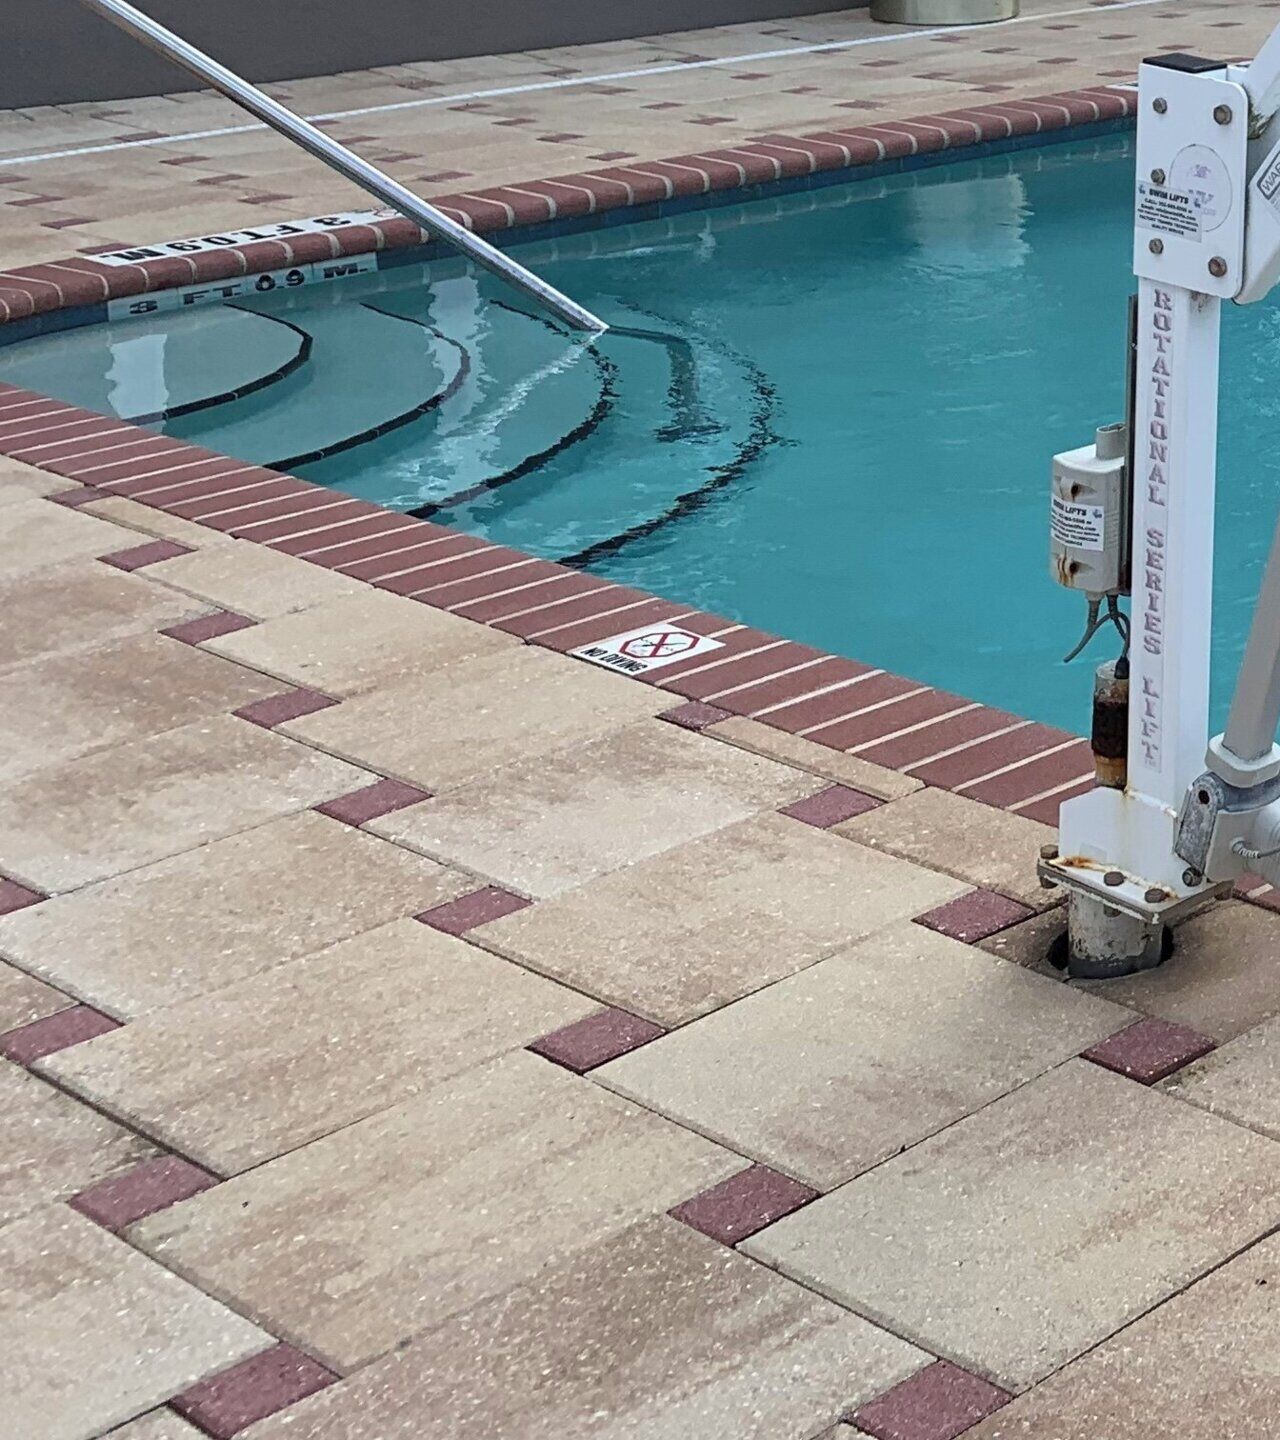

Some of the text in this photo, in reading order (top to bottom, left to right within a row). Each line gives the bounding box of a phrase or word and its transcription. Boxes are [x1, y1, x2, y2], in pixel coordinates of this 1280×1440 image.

[1169, 193, 1189, 204] LIFTS
[1149, 288, 1172, 507] ROTATIONAL
[1143, 528, 1164, 655] SERIES
[581, 646, 648, 672] NO DIVING
[1141, 675, 1160, 759] LIFT
